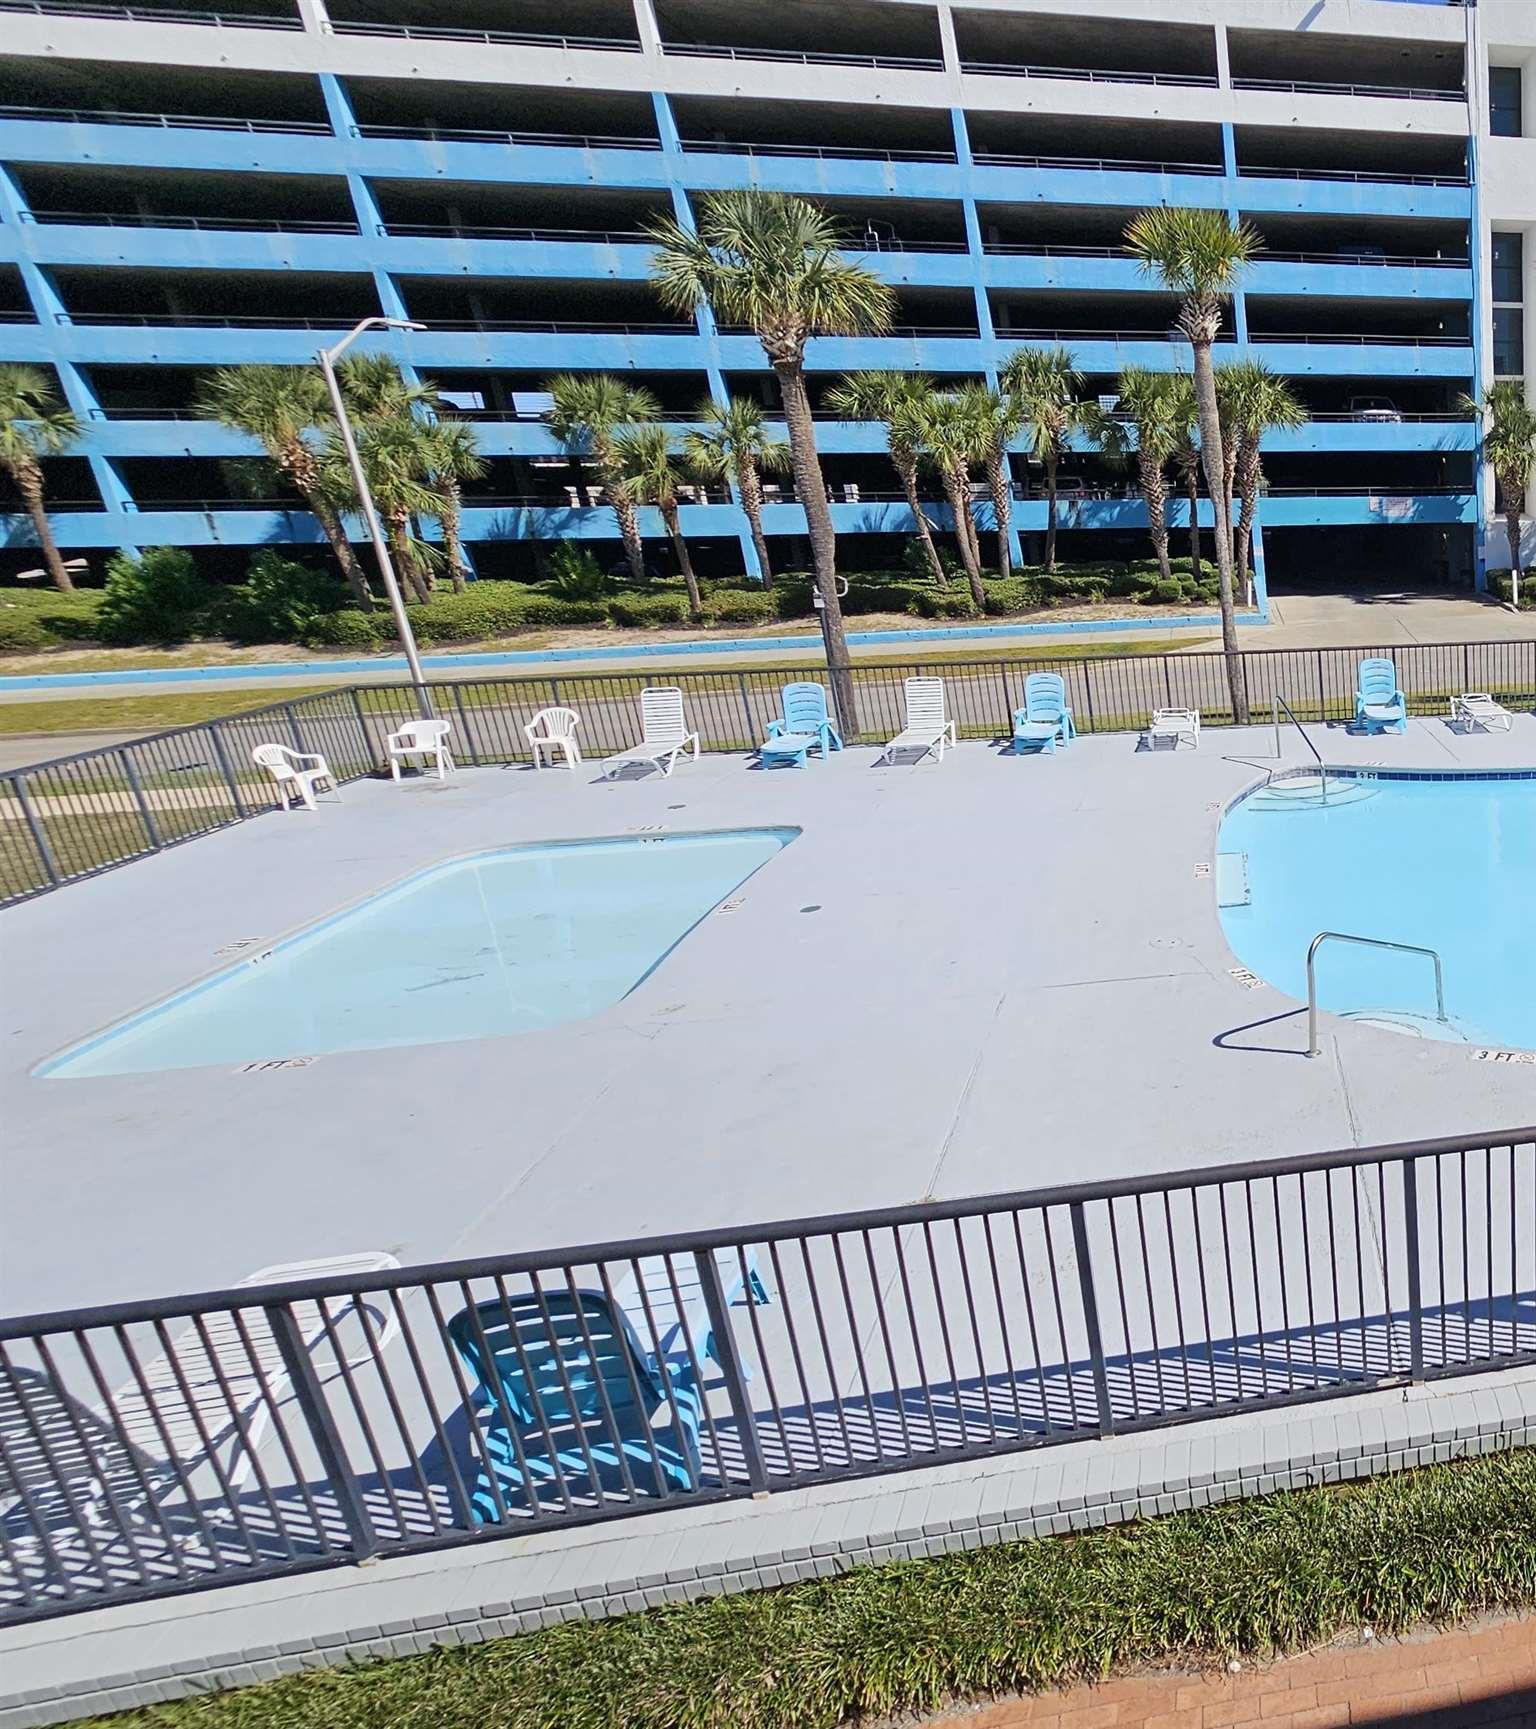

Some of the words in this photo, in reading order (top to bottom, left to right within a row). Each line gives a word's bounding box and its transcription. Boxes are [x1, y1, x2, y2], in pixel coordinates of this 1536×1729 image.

[1479, 1050, 1489, 1060] 3
[1494, 1052, 1516, 1062] FT
[259, 1059, 292, 1071] FT
